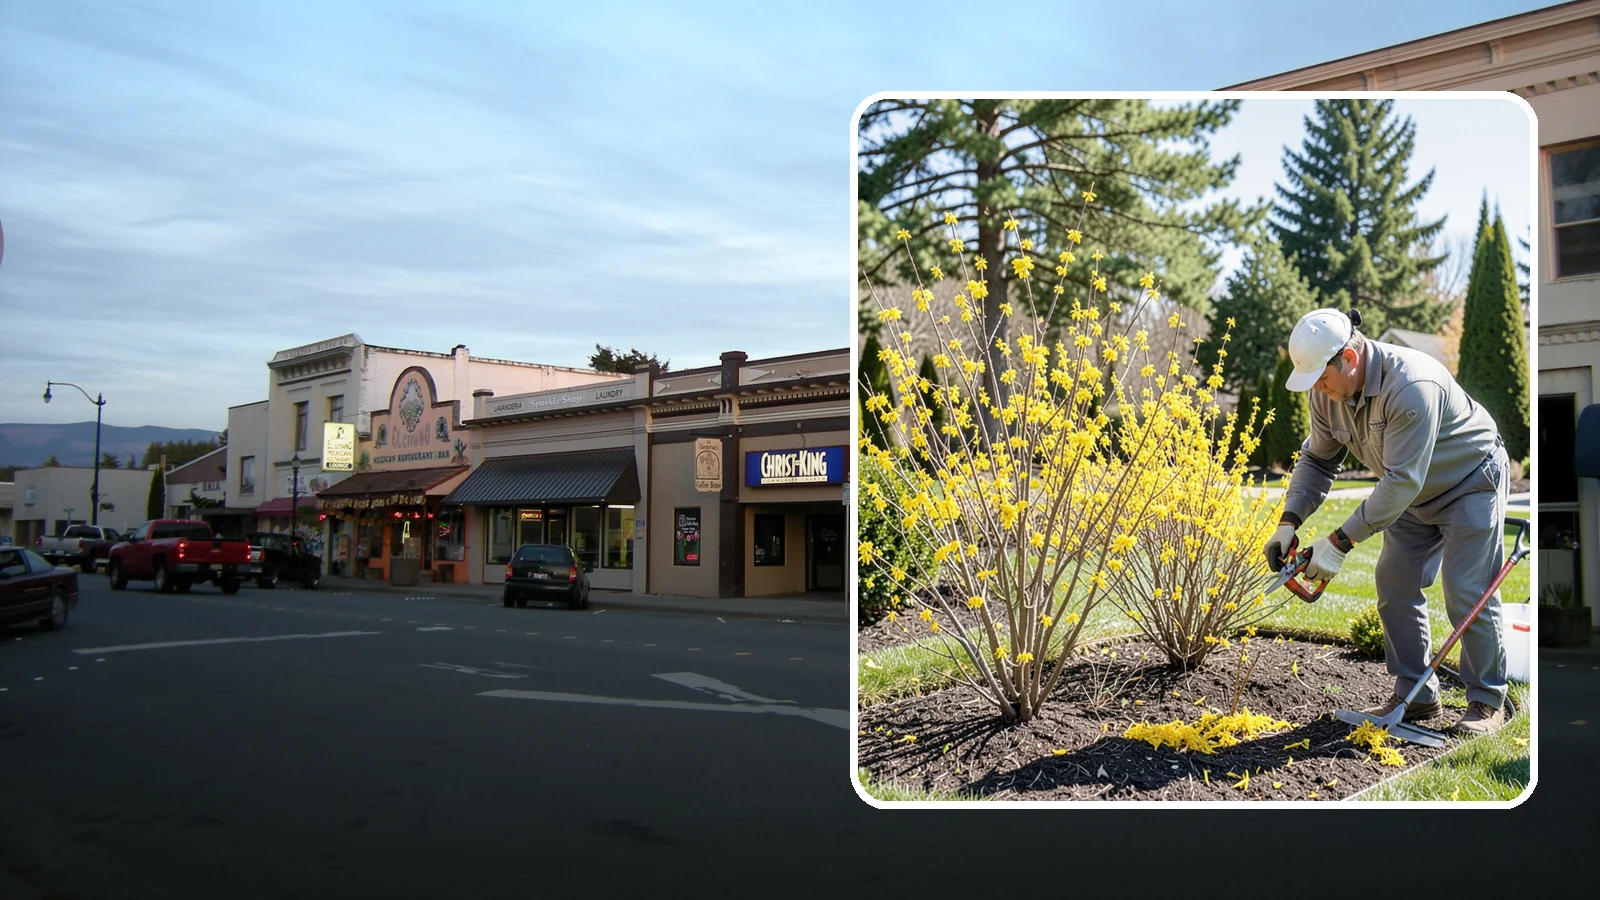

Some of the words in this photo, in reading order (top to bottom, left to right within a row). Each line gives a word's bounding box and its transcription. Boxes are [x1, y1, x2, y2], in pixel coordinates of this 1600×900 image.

[561, 394, 582, 405] Shop
[595, 389, 623, 400] LAUNDRY
[373, 455, 396, 464] MEXICAN
[397, 452, 433, 462] RESTAURANT
[438, 450, 450, 459] BAR
[799, 450, 827, 476] KING
[696, 481, 709, 489] Coffee
[710, 481, 721, 489] House
